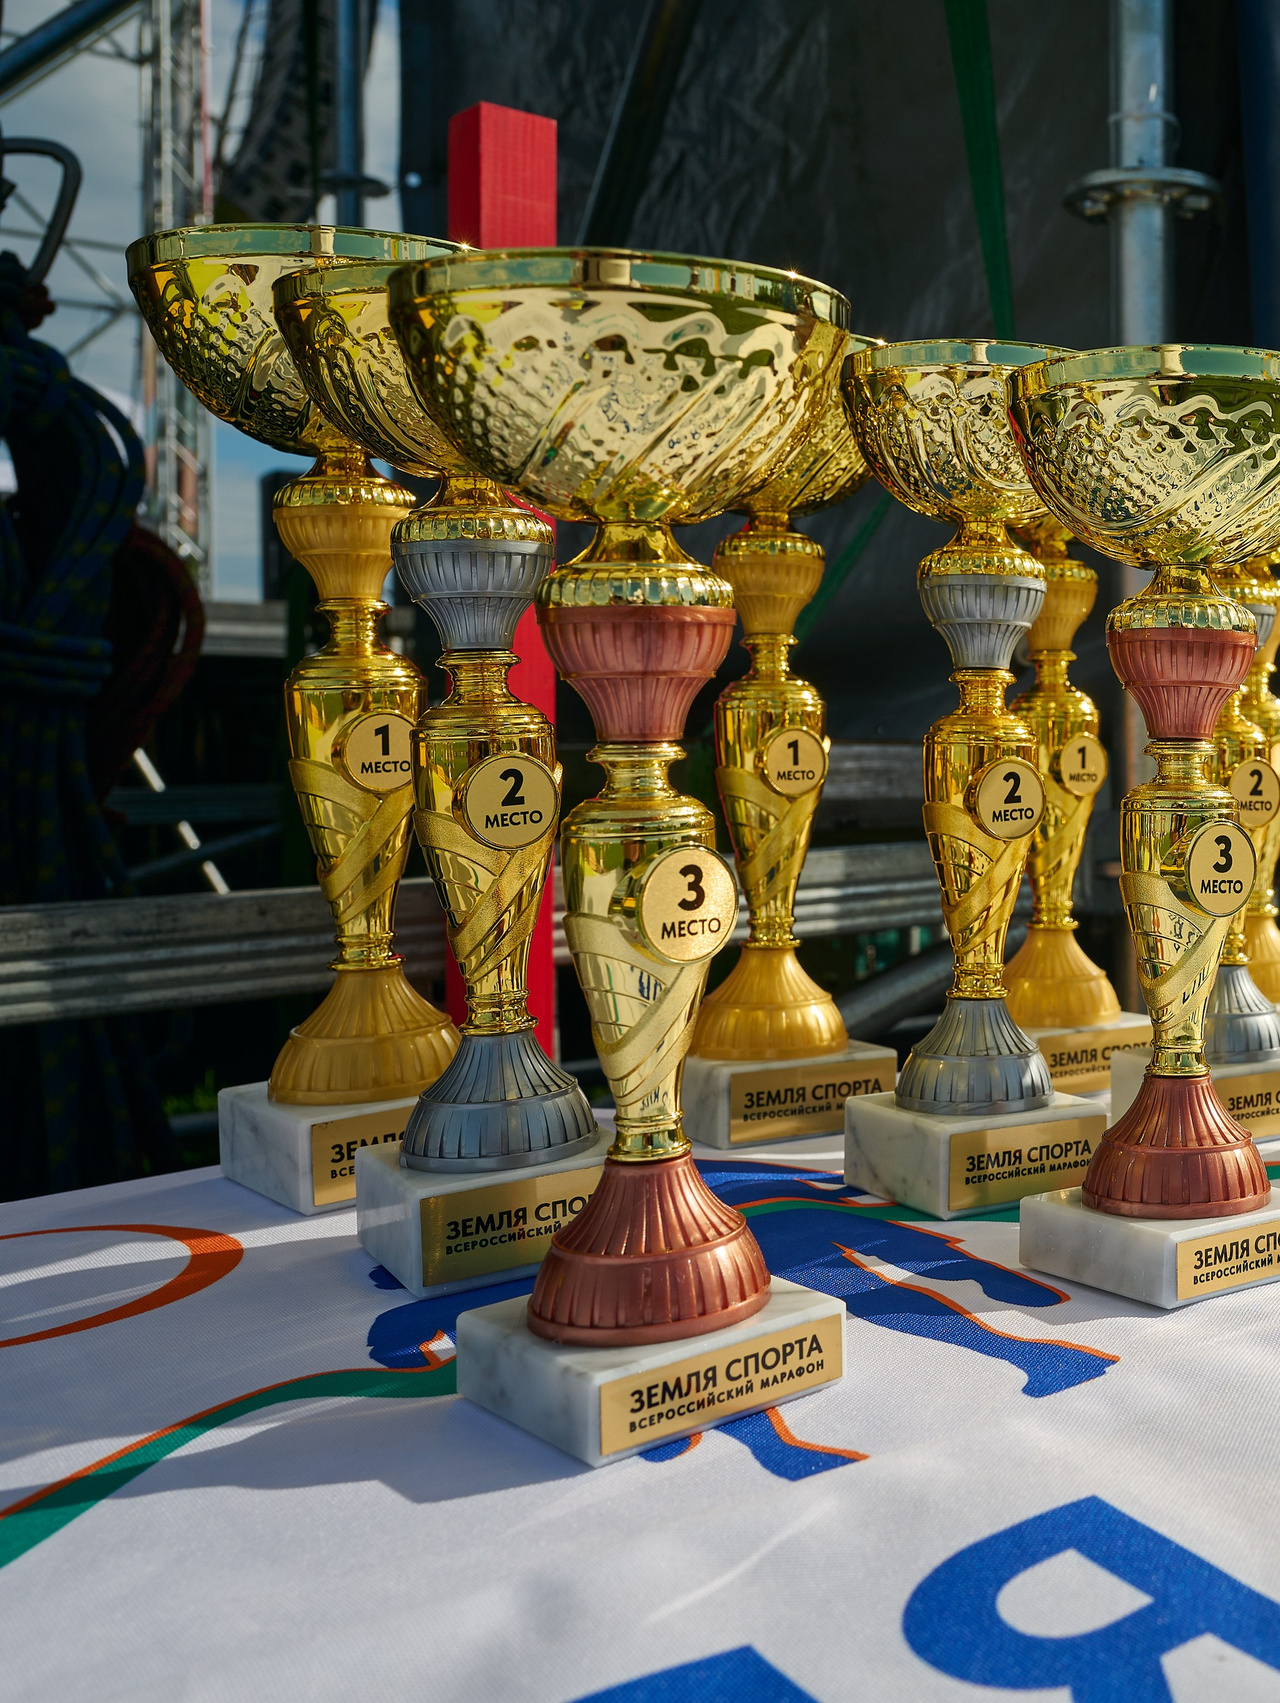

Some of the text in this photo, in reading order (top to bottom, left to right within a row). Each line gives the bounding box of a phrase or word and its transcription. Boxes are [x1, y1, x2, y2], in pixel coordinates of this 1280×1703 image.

[374, 724, 390, 756] 1
[787, 739, 799, 766] 1
[360, 760, 411, 774] МЕСТО
[1077, 746, 1087, 769] 1
[499, 768, 525, 807] 2
[776, 770, 816, 781] МЕСТО
[1003, 771, 1022, 804] 2
[1069, 773, 1098, 782] МЕСТО
[1249, 769, 1263, 796] 2
[485, 810, 543, 829] МЕСТО
[992, 808, 1034, 822] МЕСТО
[1240, 801, 1272, 812] МЕСТО
[1212, 835, 1233, 873] 3
[677, 864, 706, 911] 3
[1200, 879, 1244, 894] МЕСТО
[661, 917, 721, 940] МЕСТО
[1050, 1048, 1098, 1068] ЗЕМЛЯ
[744, 1078, 883, 1109] ЗЕМЛЯ СПОРТА
[1228, 1092, 1272, 1112] ЗЕМЛЯ
[743, 1102, 832, 1122] ВСЕРОССИЙСКИЙ
[965, 1139, 1092, 1172] ЗЕМЛЯ СПОРТА
[964, 1163, 1046, 1186] ВСЕРОССИЙСКИЙ
[445, 1206, 528, 1240] ЗЕМЛЯ
[445, 1220, 562, 1256] ВСЕРОССИЙСКИЙ
[1194, 1238, 1250, 1270] ЗЕМЛЯ
[1193, 1254, 1274, 1285] ВСЕРОССИЙСКИЙ
[630, 1334, 824, 1414] ЗЕМЛЯ СПОРТА
[629, 1358, 824, 1433] ВСЕРОССИЙСКИЙ МАРАФОН
